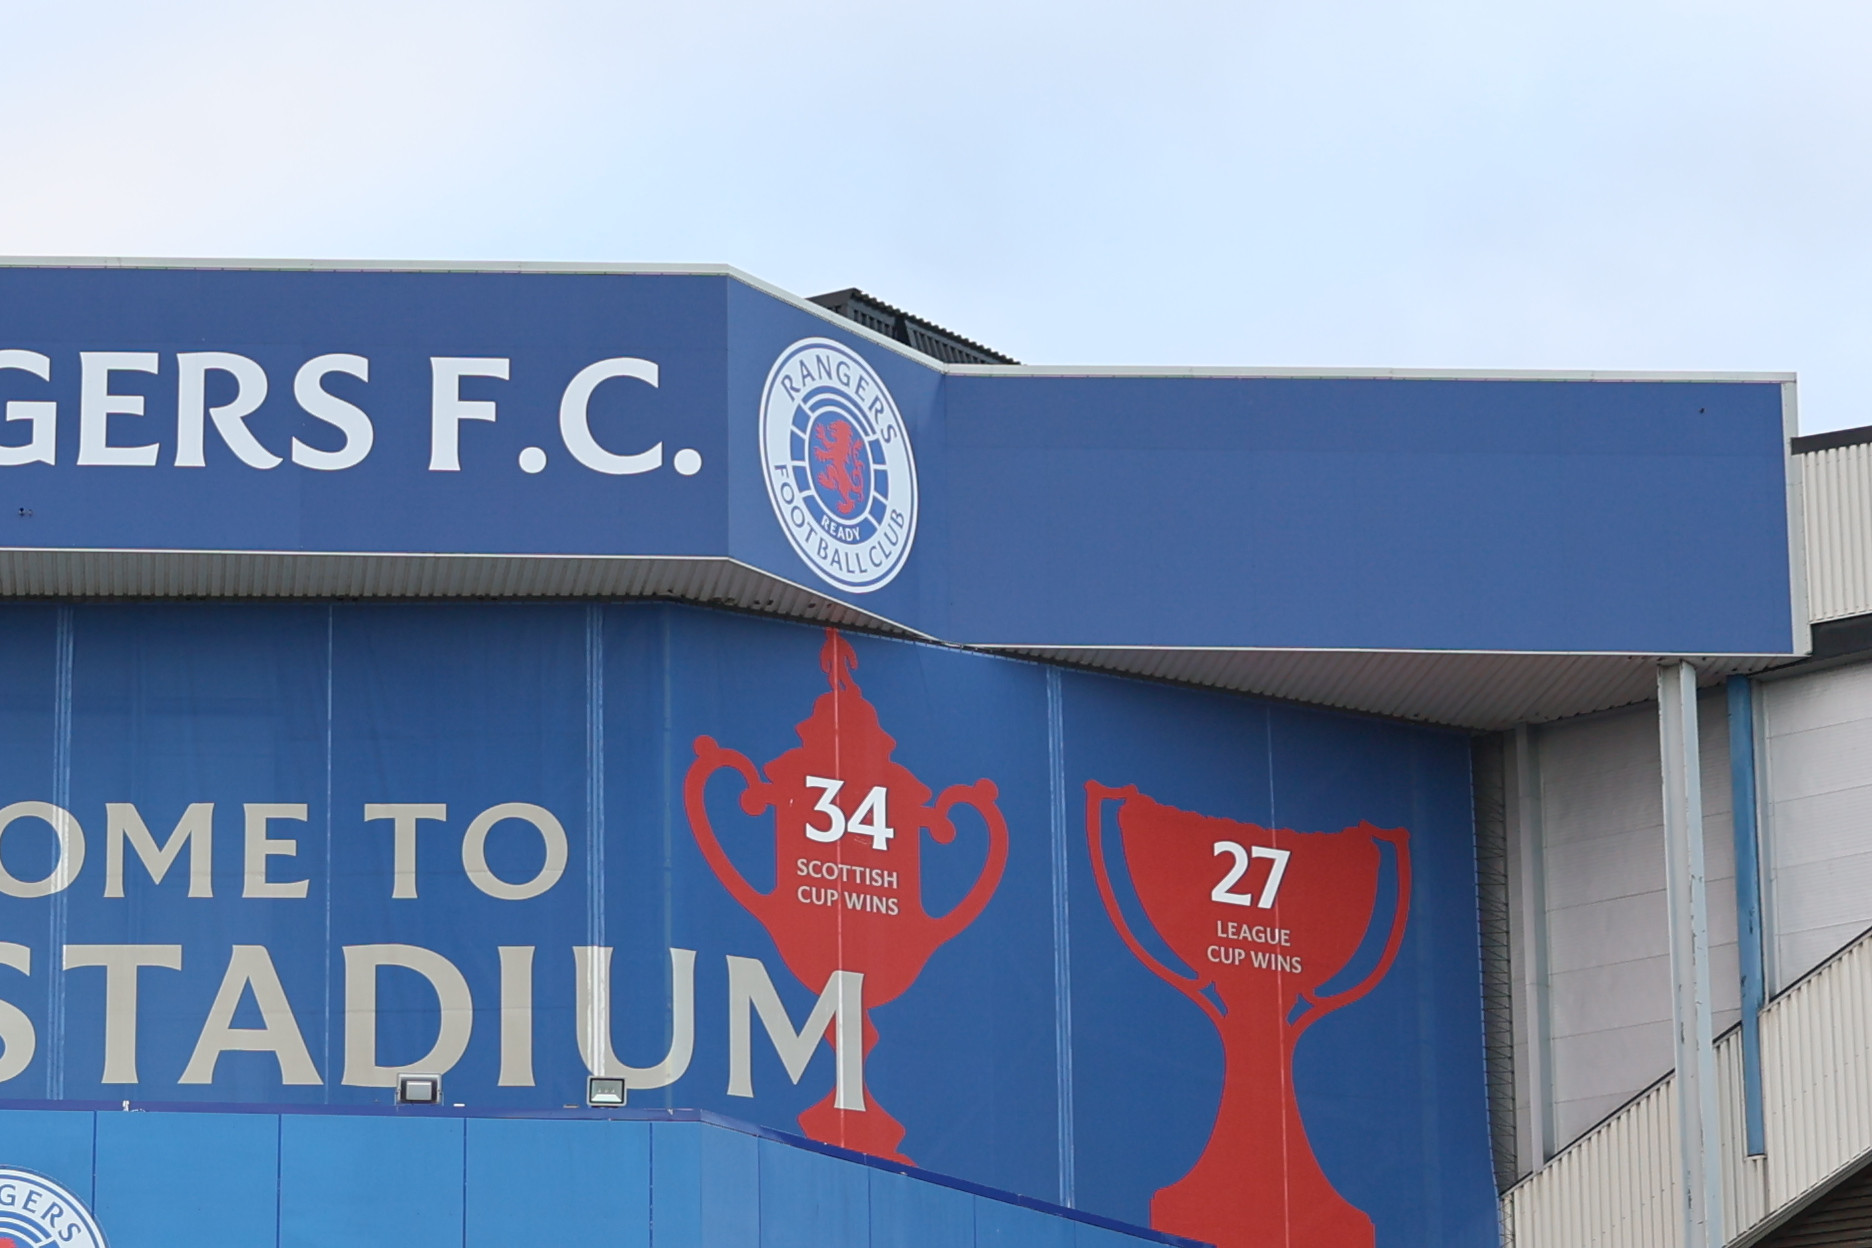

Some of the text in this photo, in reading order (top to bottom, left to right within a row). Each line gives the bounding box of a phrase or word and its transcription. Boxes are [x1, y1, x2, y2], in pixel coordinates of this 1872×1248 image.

[429, 353, 704, 478] F.C.
[780, 354, 898, 445] RANGERS
[773, 463, 905, 575] FOOTBALL CLUB
[821, 514, 861, 541] READY
[805, 774, 895, 851] 34
[363, 801, 568, 901] TO
[796, 858, 898, 889] SCOTTISH
[1211, 840, 1292, 909] 27
[797, 885, 899, 916] CUP WINS
[1217, 920, 1291, 947] LEAGUE
[1207, 945, 1303, 974] CUP WINS
